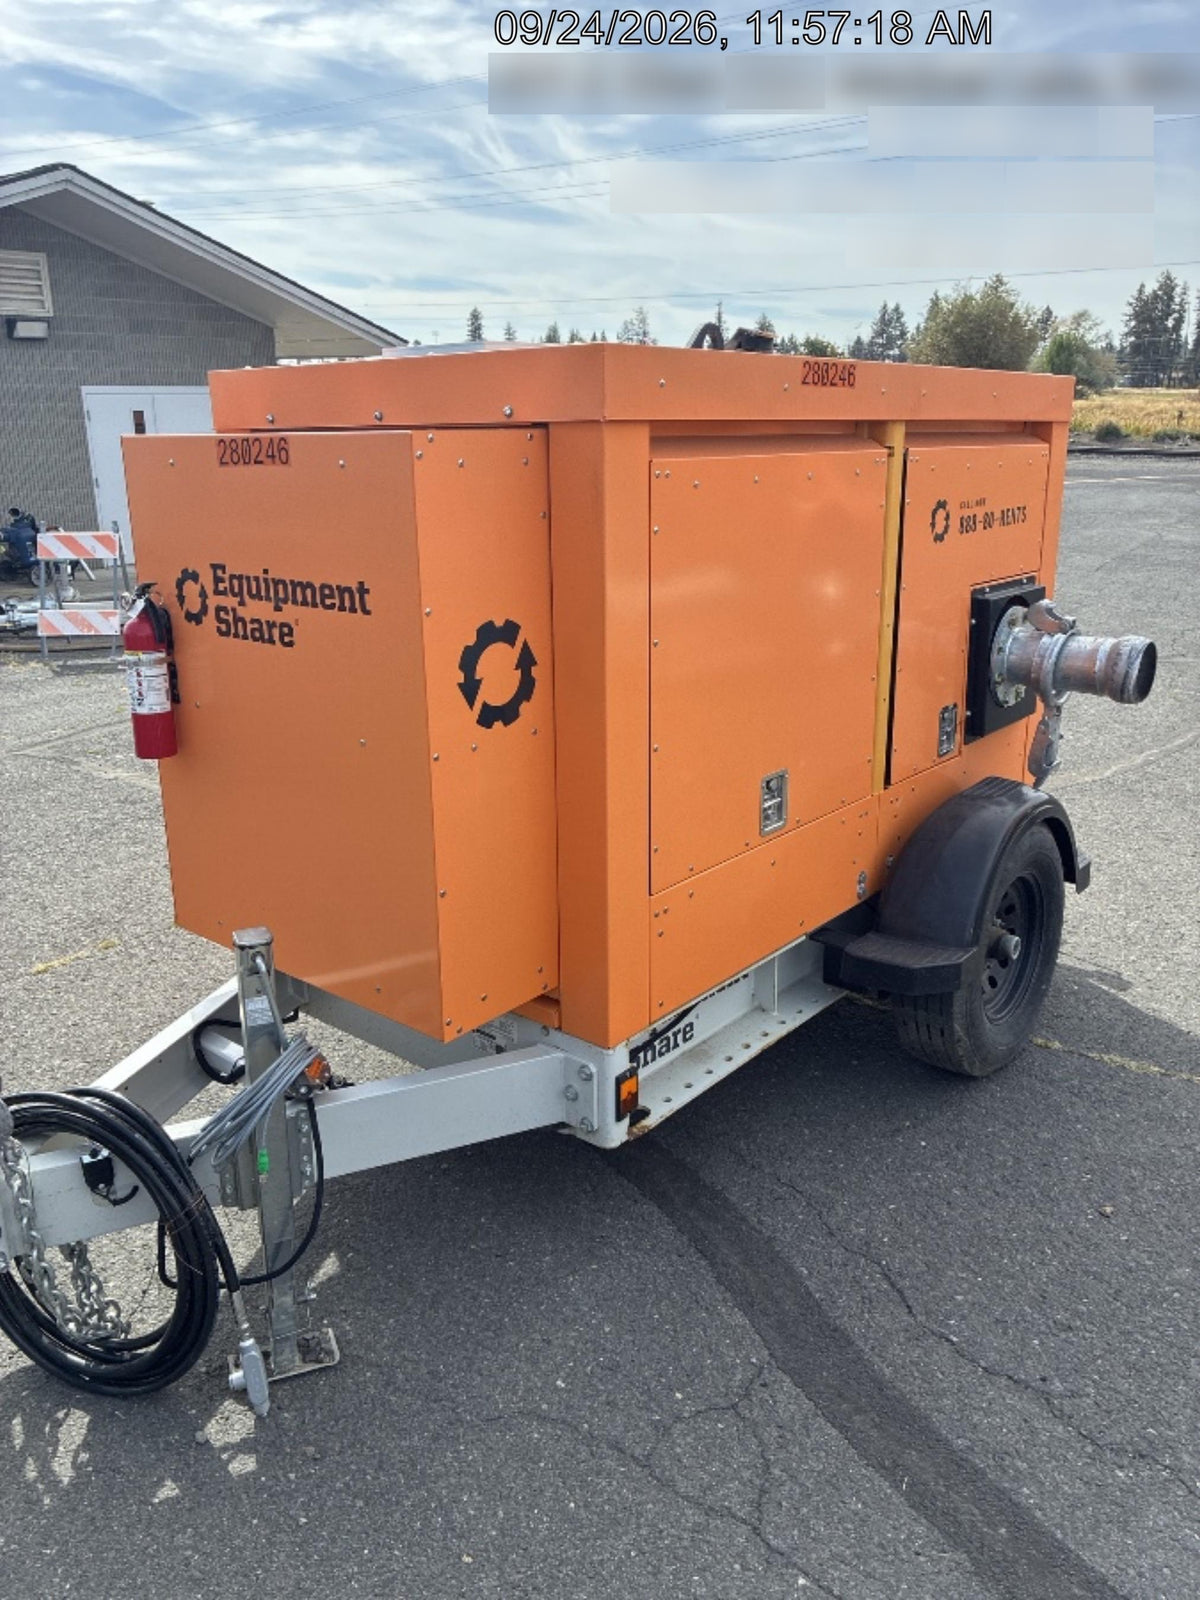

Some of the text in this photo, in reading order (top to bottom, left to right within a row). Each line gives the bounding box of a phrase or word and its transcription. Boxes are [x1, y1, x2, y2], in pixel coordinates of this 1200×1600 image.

[801, 360, 856, 388] 280246
[217, 437, 290, 466] 280246
[209, 563, 372, 616] Equipment
[214, 604, 295, 648] Share
